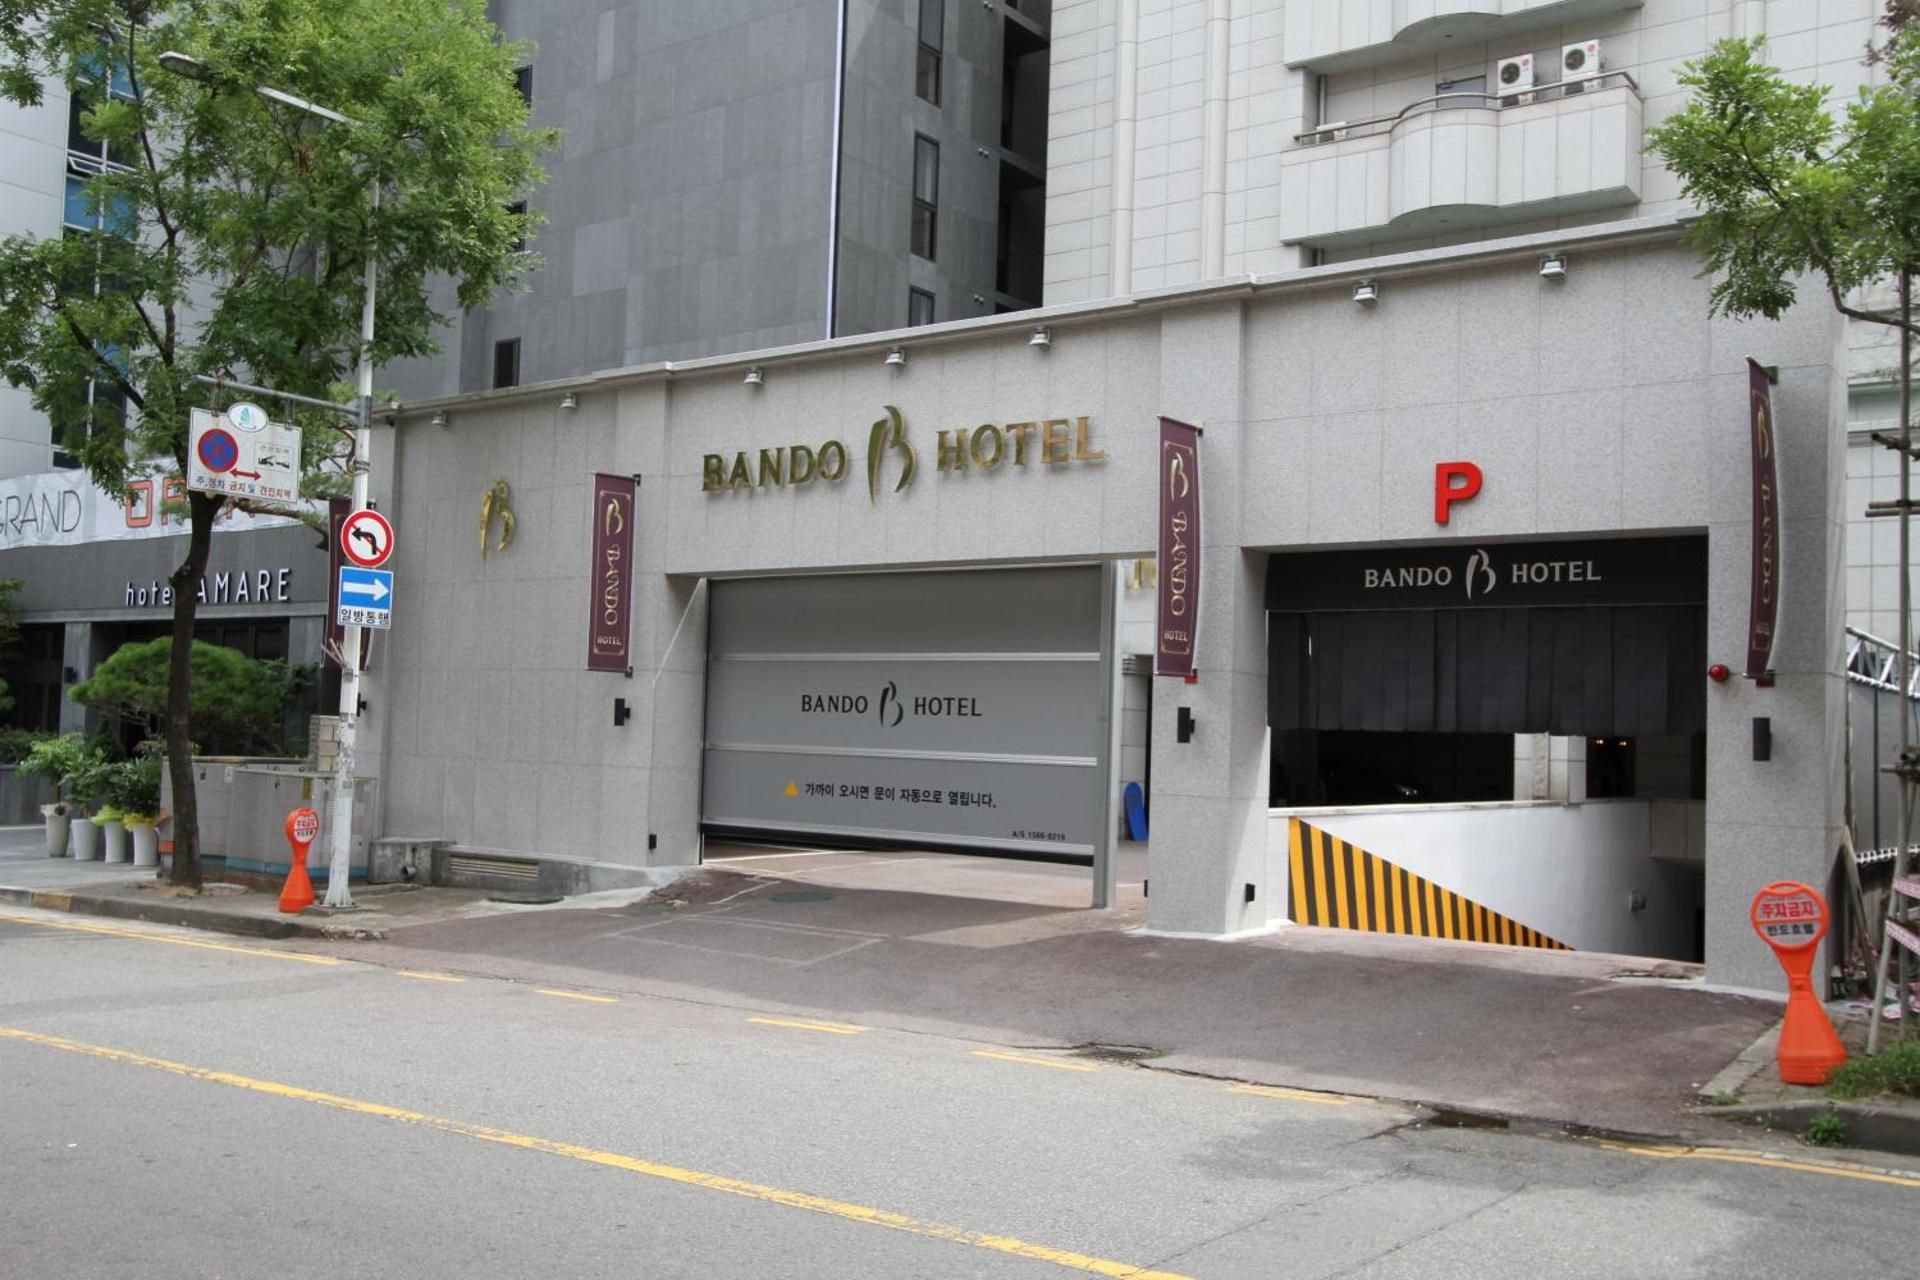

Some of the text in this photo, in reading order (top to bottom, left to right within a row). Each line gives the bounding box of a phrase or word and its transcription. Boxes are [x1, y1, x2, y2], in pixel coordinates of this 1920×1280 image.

[702, 439, 849, 493] BANDO
[936, 415, 1109, 472] HOTEL
[1434, 461, 1483, 525] P
[1170, 511, 1188, 616] BANDO
[1364, 566, 1452, 588] BANDO
[1511, 560, 1602, 583] HOTEL
[604, 543, 621, 626] BANDO
[341, 608, 389, 625] 일방통행
[1164, 630, 1188, 642] HOTEL
[801, 694, 868, 714] BANDO
[914, 696, 982, 717] HOTEL
[805, 782, 997, 808] 가까이 오시면 문이 자동으로 열립니다.
[1763, 901, 1814, 918] 주차금지
